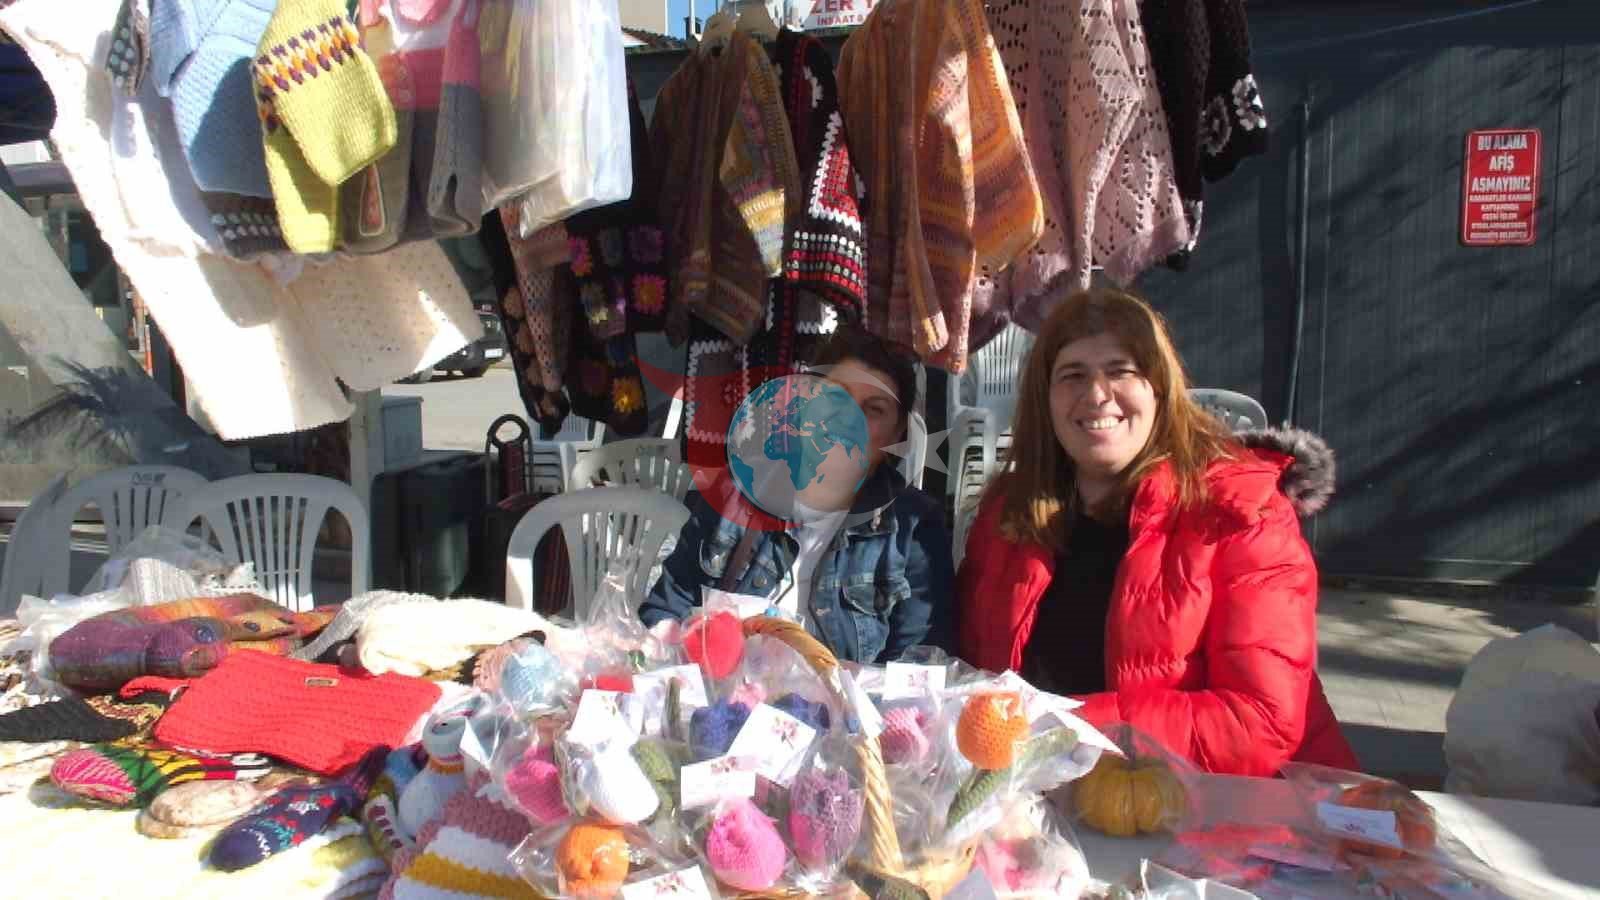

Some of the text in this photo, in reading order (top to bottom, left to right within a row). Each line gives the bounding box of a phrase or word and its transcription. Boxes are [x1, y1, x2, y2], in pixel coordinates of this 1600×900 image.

[1493, 135, 1527, 150] ALANA
[1489, 153, 1514, 173] AFİŞ
[1472, 176, 1530, 191] ASMAYINIZ
